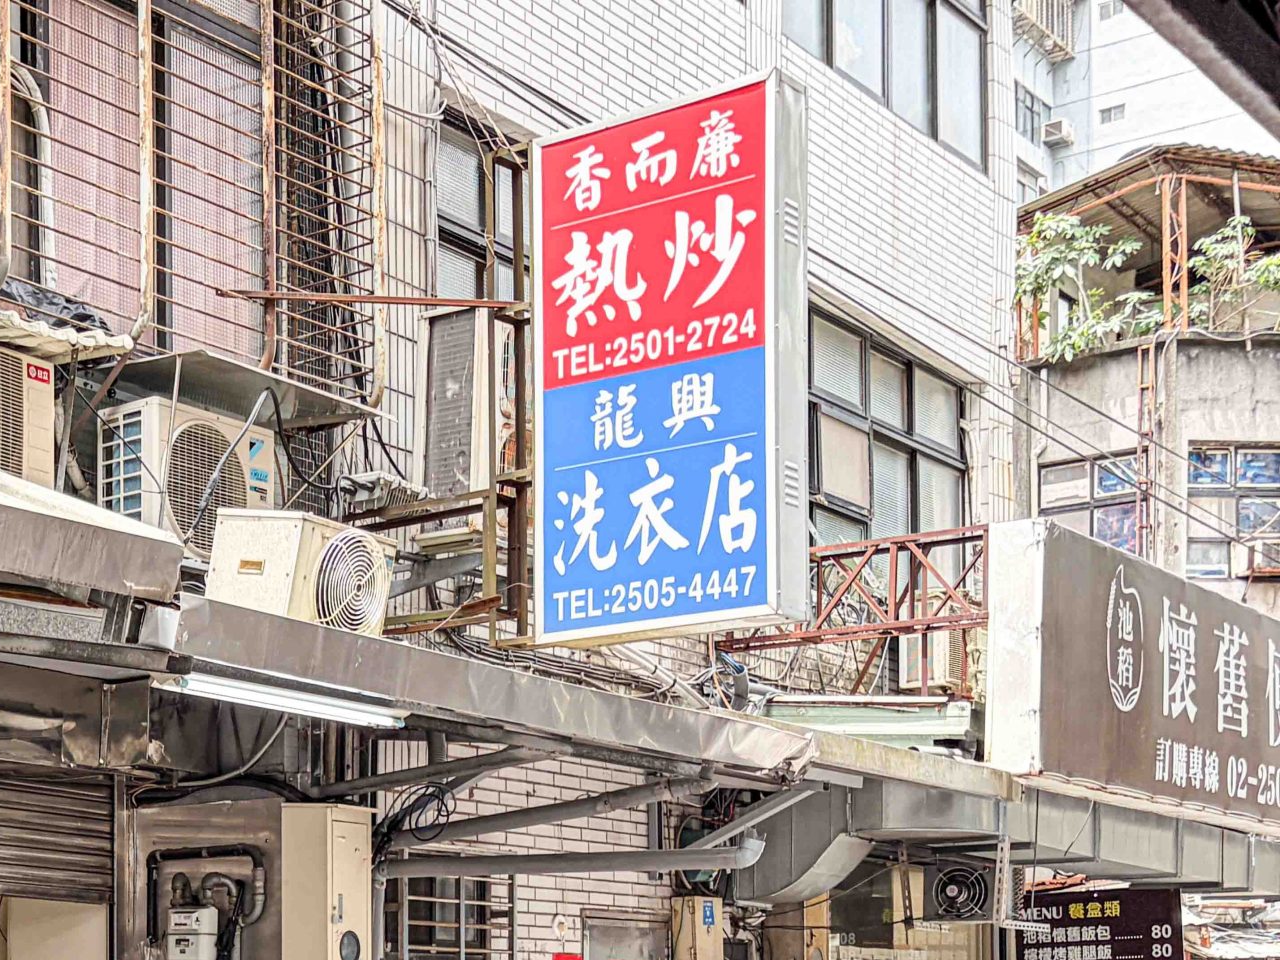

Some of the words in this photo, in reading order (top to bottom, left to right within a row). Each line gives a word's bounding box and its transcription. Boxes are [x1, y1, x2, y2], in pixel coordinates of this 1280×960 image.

[563, 109, 742, 212] 香而廉
[551, 193, 757, 338] 熱炒
[552, 308, 757, 381] TEL:2501-2724
[590, 373, 721, 451] 龍興
[553, 443, 755, 576] 洗衣店
[553, 565, 757, 622] TEL:2505-4447
[1155, 736, 1219, 794] 訂購專線
[1019, 906, 1062, 920] MENU
[1069, 900, 1120, 919] 餐盒類
[1151, 924, 1172, 939] 80
[1152, 944, 1173, 958] 80
